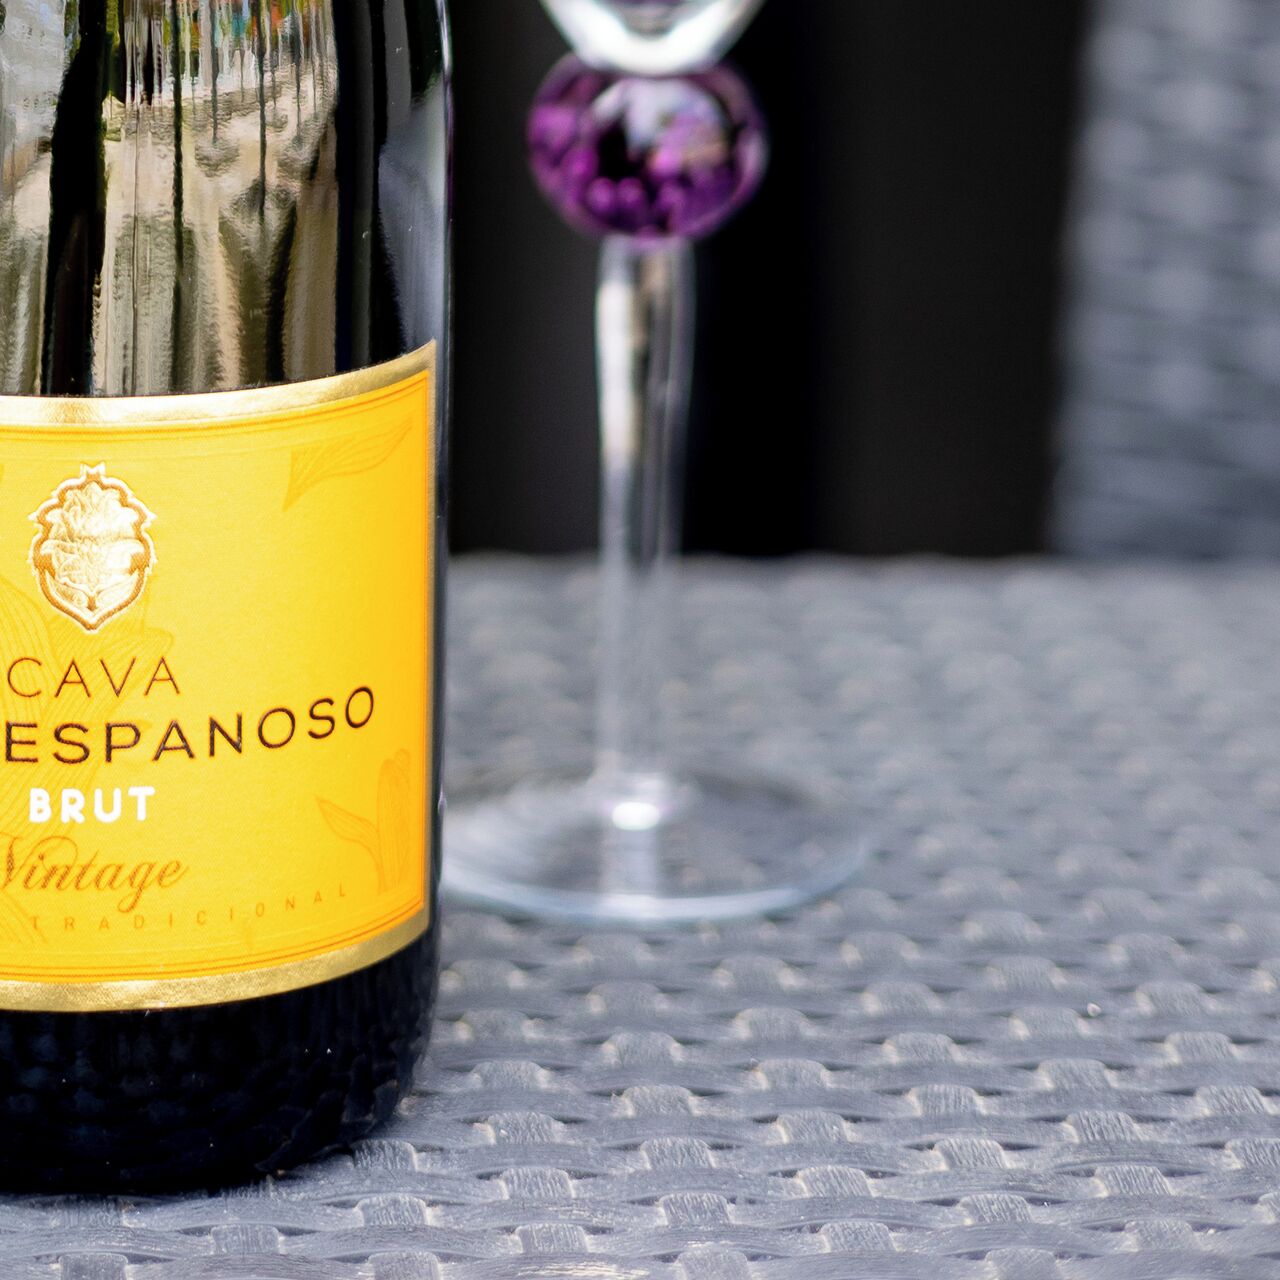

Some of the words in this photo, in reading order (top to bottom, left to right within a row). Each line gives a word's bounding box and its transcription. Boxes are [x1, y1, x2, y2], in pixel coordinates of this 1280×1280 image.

[7, 656, 181, 699] CAVA
[5, 686, 375, 764] ESPANOSO
[28, 786, 155, 824] BRUT
[30, 882, 346, 931] TRADICIONAL
